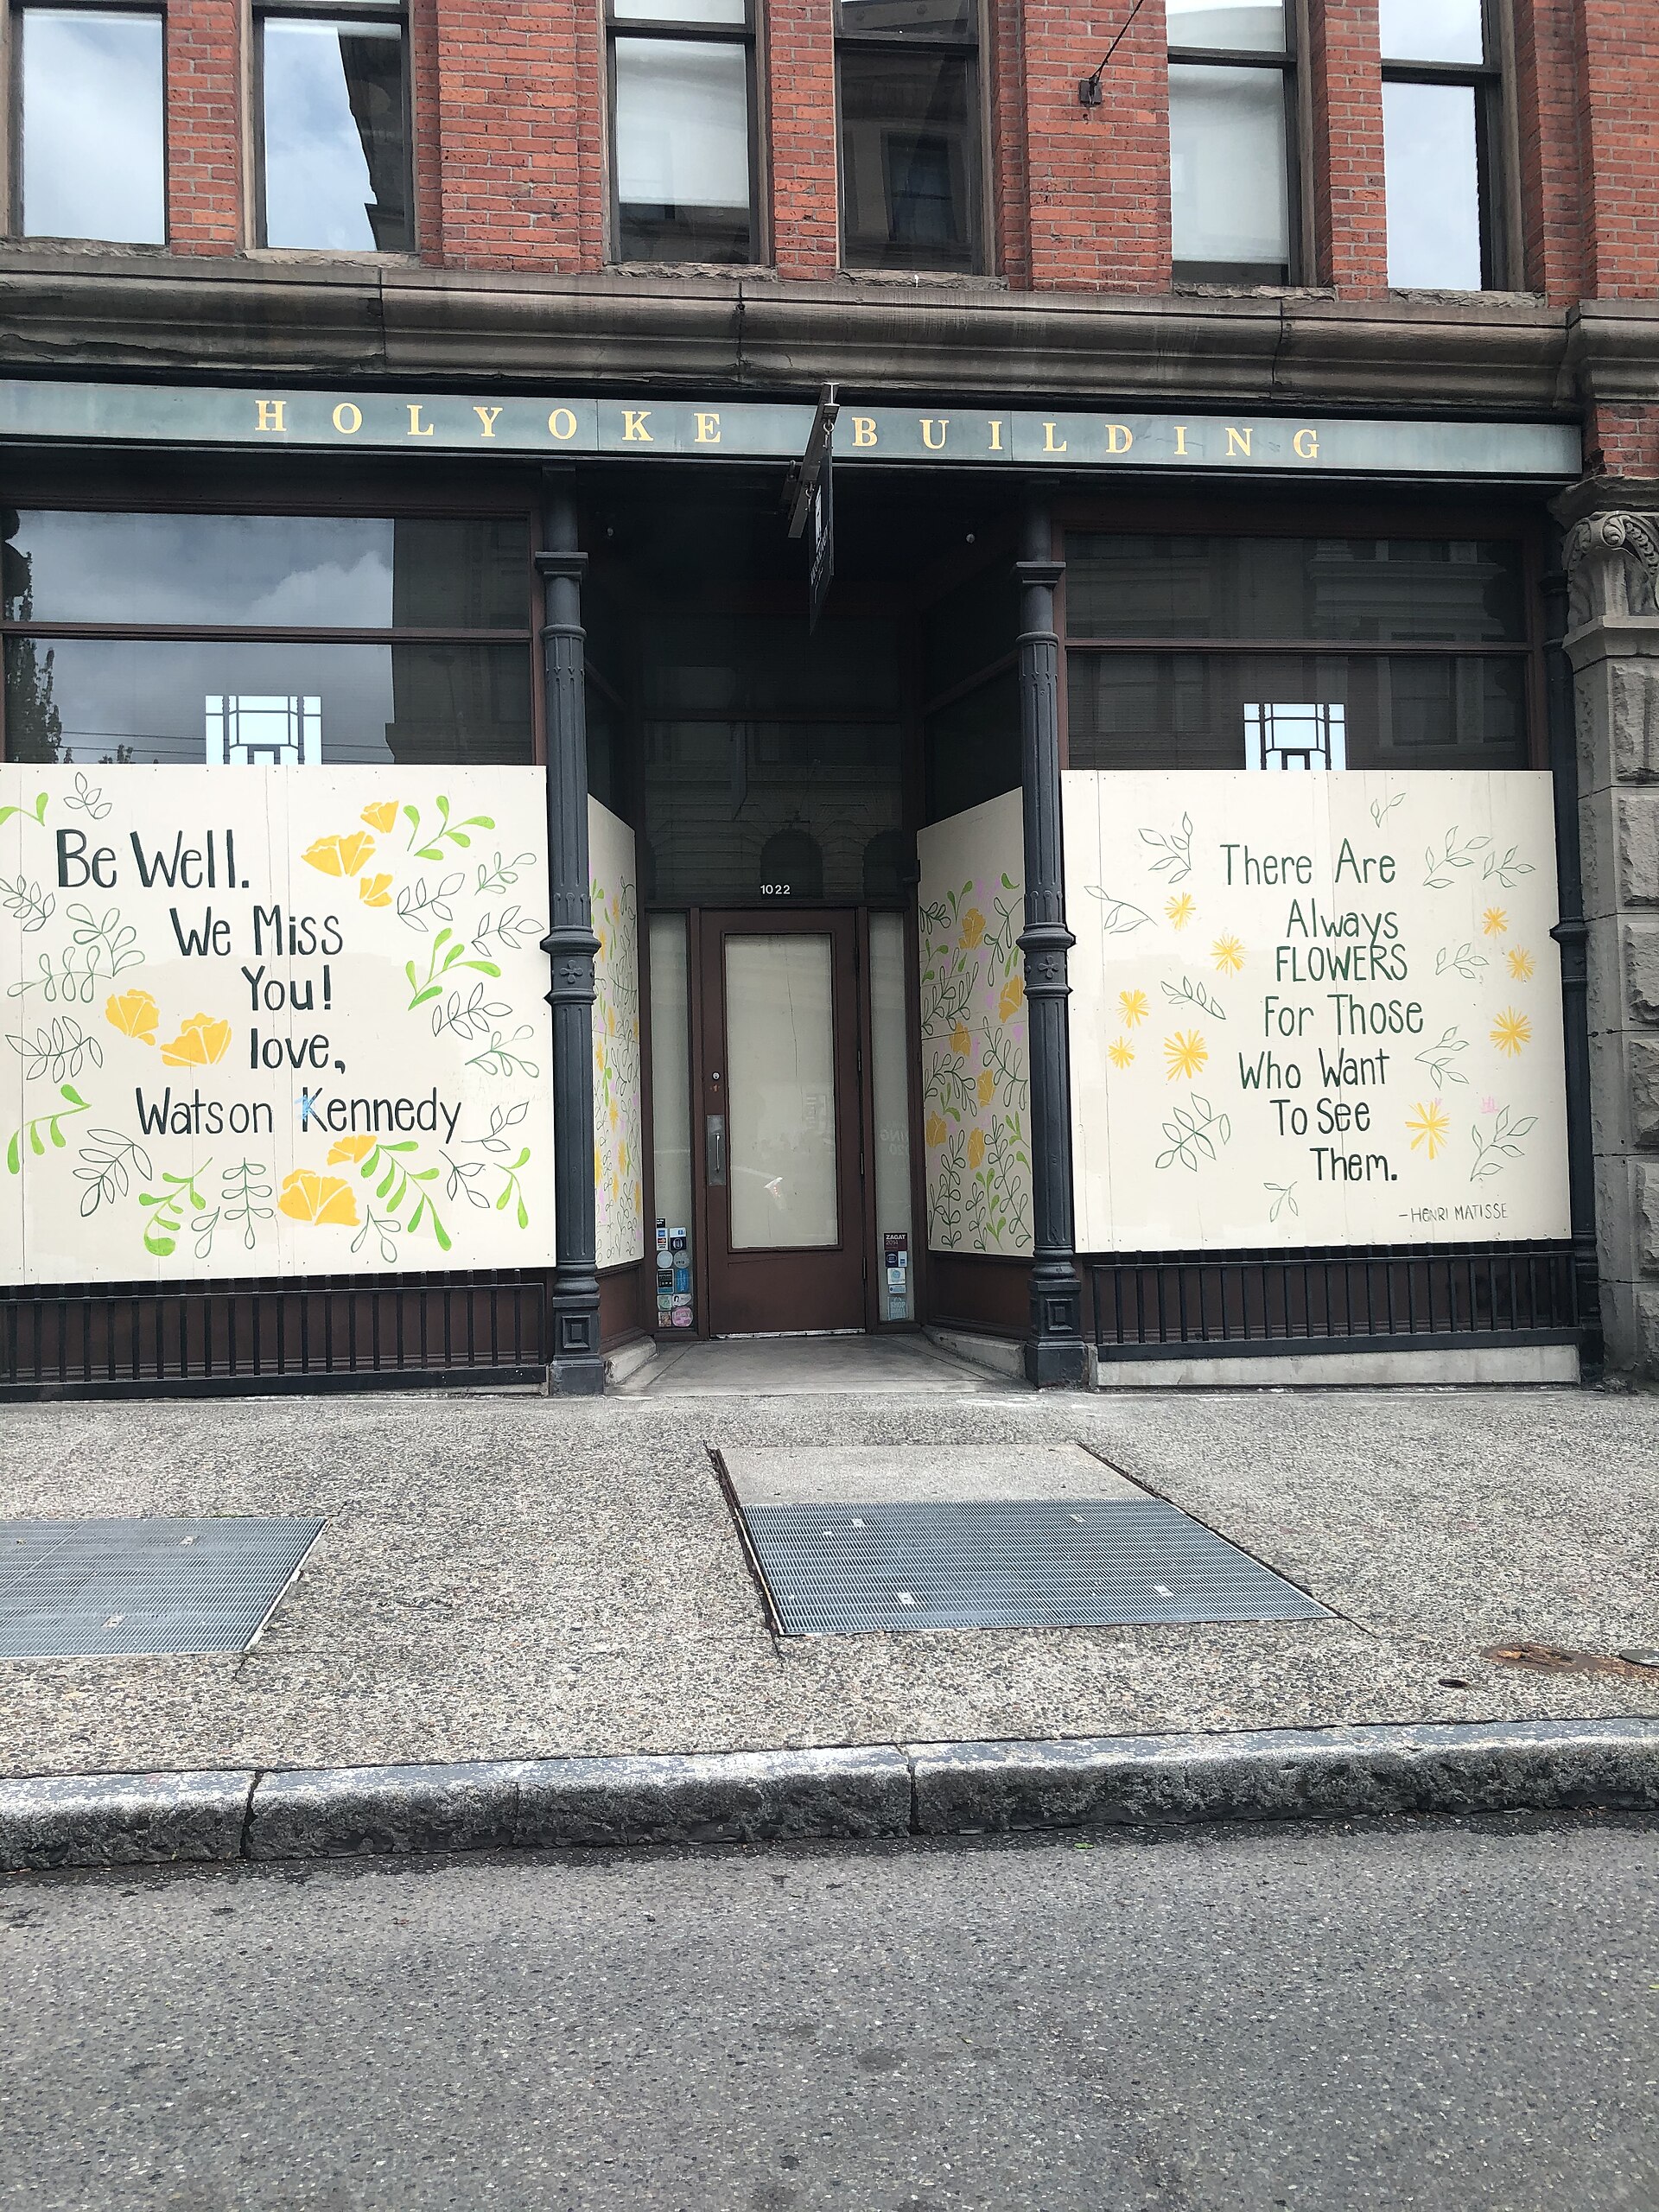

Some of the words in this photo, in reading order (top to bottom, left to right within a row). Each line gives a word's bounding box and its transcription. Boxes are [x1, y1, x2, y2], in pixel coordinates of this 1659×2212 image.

[254, 400, 721, 443] HOLYOKE
[851, 416, 1320, 459] BUILDING
[56, 829, 117, 888] Be
[130, 829, 250, 888] Well.
[1220, 844, 1312, 886] There
[1335, 838, 1395, 883] Are
[760, 884, 791, 894] 1022
[169, 906, 231, 957] We
[253, 905, 343, 956] Miss
[1287, 899, 1398, 949] Always
[1276, 944, 1408, 982] FLOWERS
[241, 964, 331, 1011] You!
[1265, 995, 1314, 1037] For
[1327, 994, 1423, 1036] Those
[251, 1028, 346, 1074] love,
[1239, 1051, 1301, 1090] Who
[1319, 1047, 1390, 1088] Want
[136, 1087, 272, 1135] Watson
[302, 1086, 461, 1144] Kennedy
[1269, 1099, 1307, 1135] To
[1317, 1097, 1370, 1135] See
[1309, 1147, 1397, 1181] Them.
[1454, 1202, 1509, 1220] MATISSE
